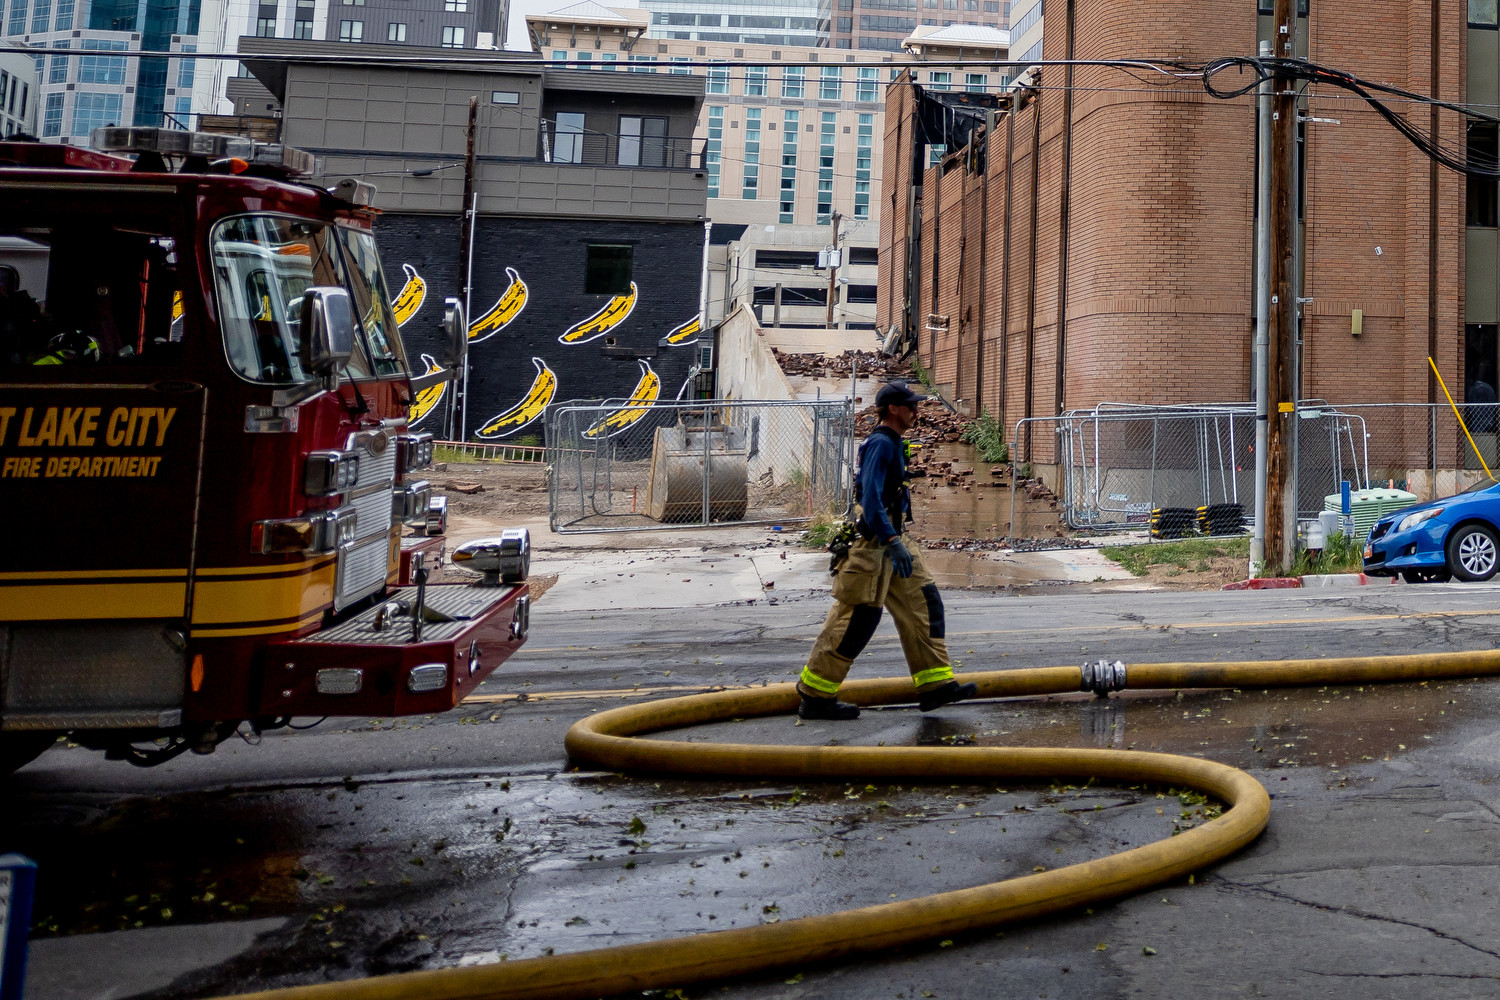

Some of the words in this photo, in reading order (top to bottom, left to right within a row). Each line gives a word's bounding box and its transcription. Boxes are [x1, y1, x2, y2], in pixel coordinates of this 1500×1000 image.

[18, 407, 101, 446] LAKE
[106, 407, 177, 446] CITY
[2, 457, 43, 477] FIRE
[45, 457, 161, 477] DEPARTMENT
